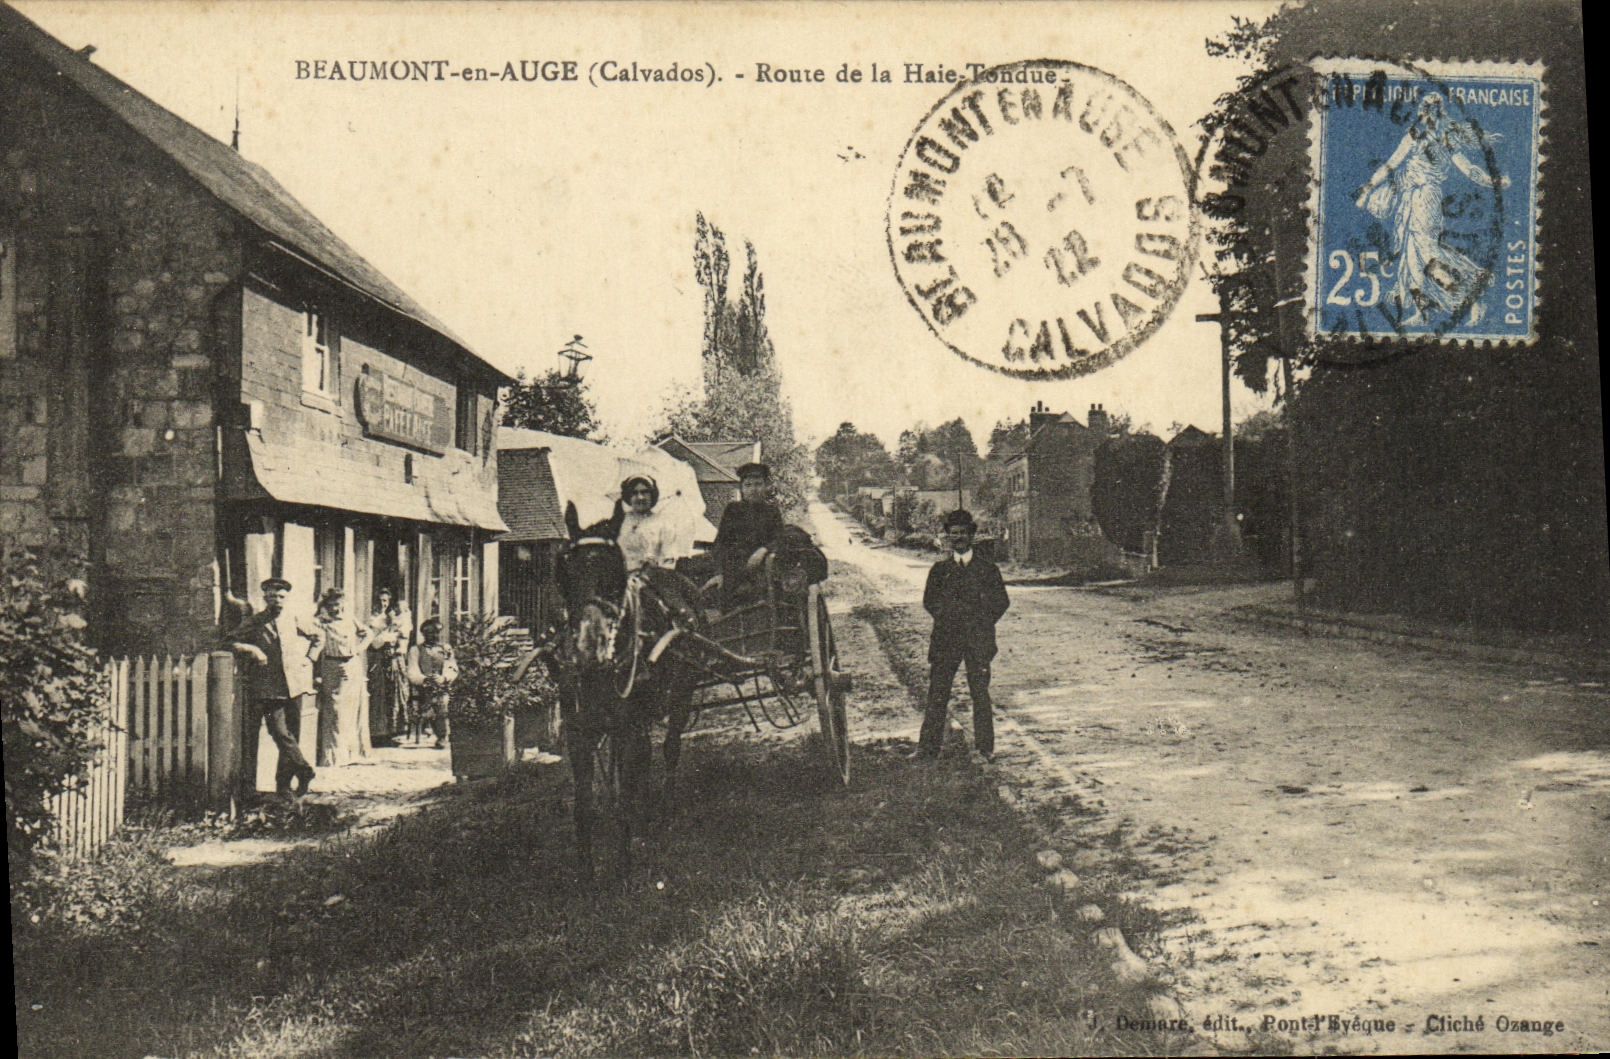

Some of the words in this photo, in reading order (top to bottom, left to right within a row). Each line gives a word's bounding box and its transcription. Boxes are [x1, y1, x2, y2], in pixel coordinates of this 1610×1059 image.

[1448, 86, 1530, 107] FRANÇAISE
[1001, 195, 1184, 363] CALVADOS
[1505, 240, 1527, 325] POSTES
